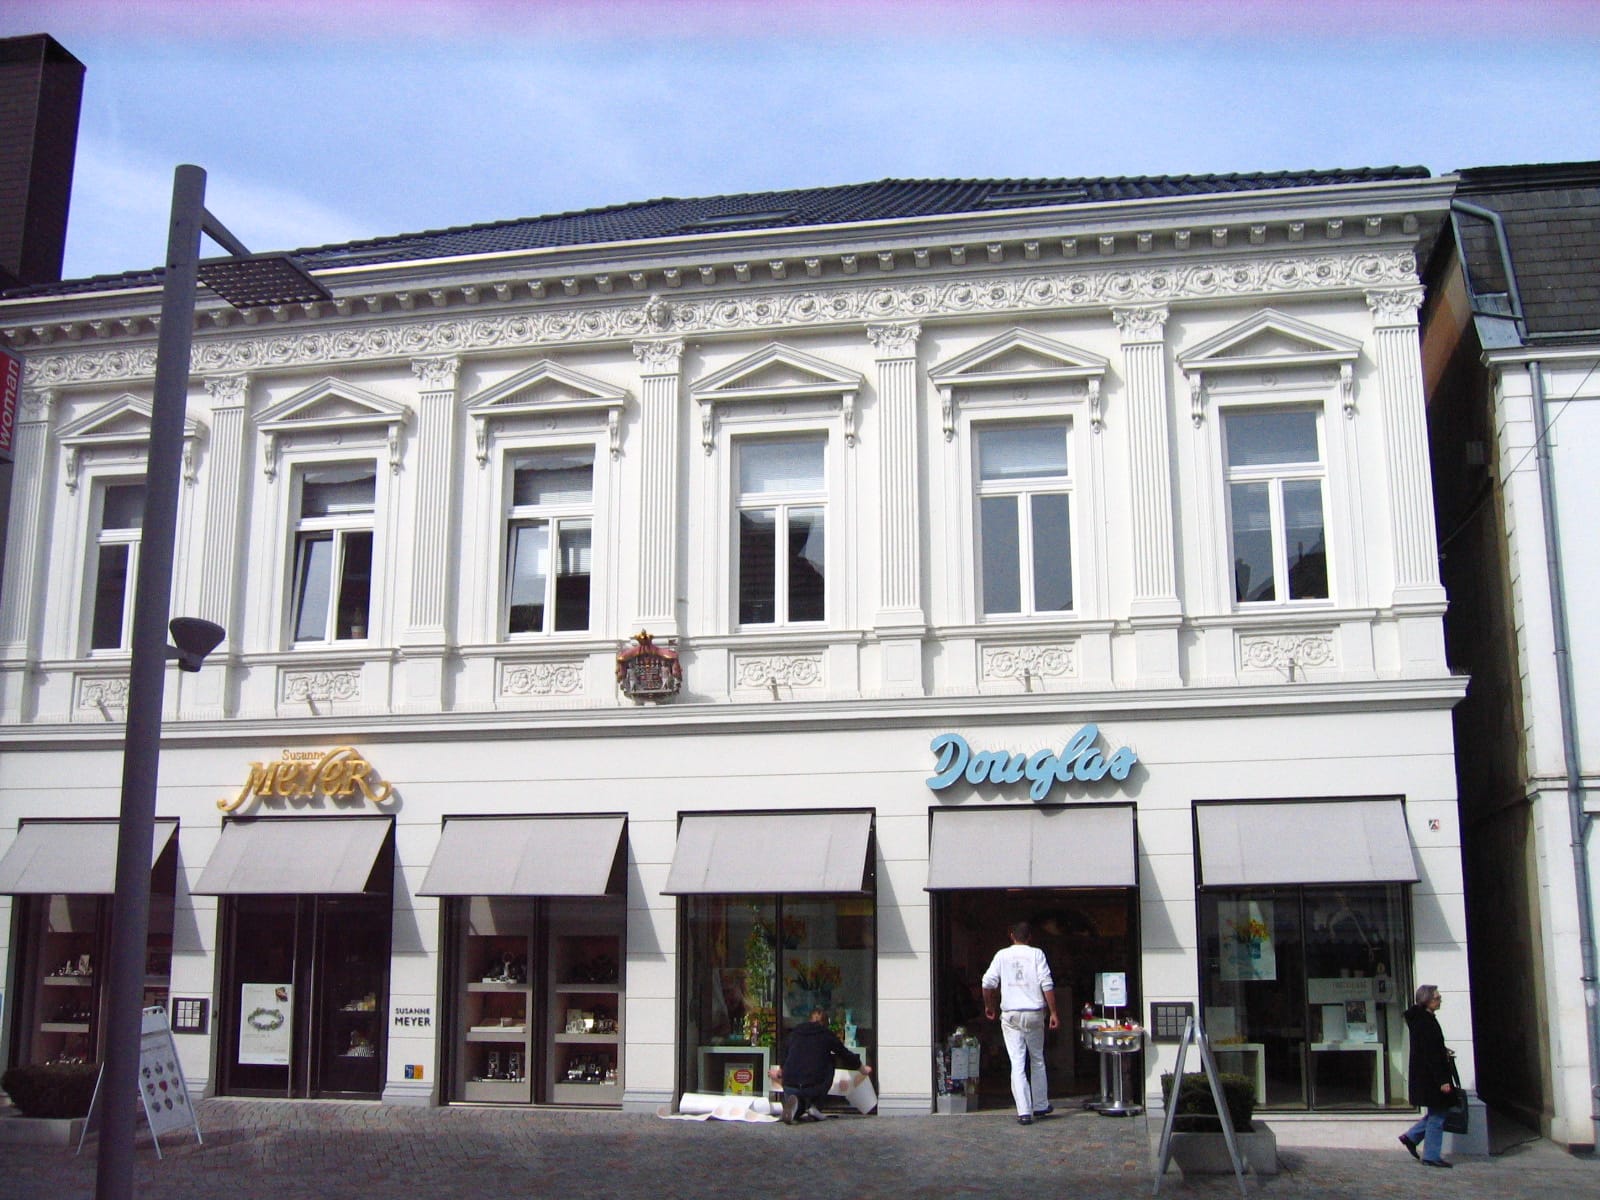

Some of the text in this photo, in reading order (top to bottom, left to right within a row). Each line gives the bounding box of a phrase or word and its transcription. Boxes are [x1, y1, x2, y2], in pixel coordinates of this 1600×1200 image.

[0, 359, 19, 446] woman
[282, 749, 325, 761] Susanne
[926, 723, 1137, 801] Douglas
[395, 1007, 431, 1015] SUSANNE
[394, 1017, 431, 1027] MEYER
